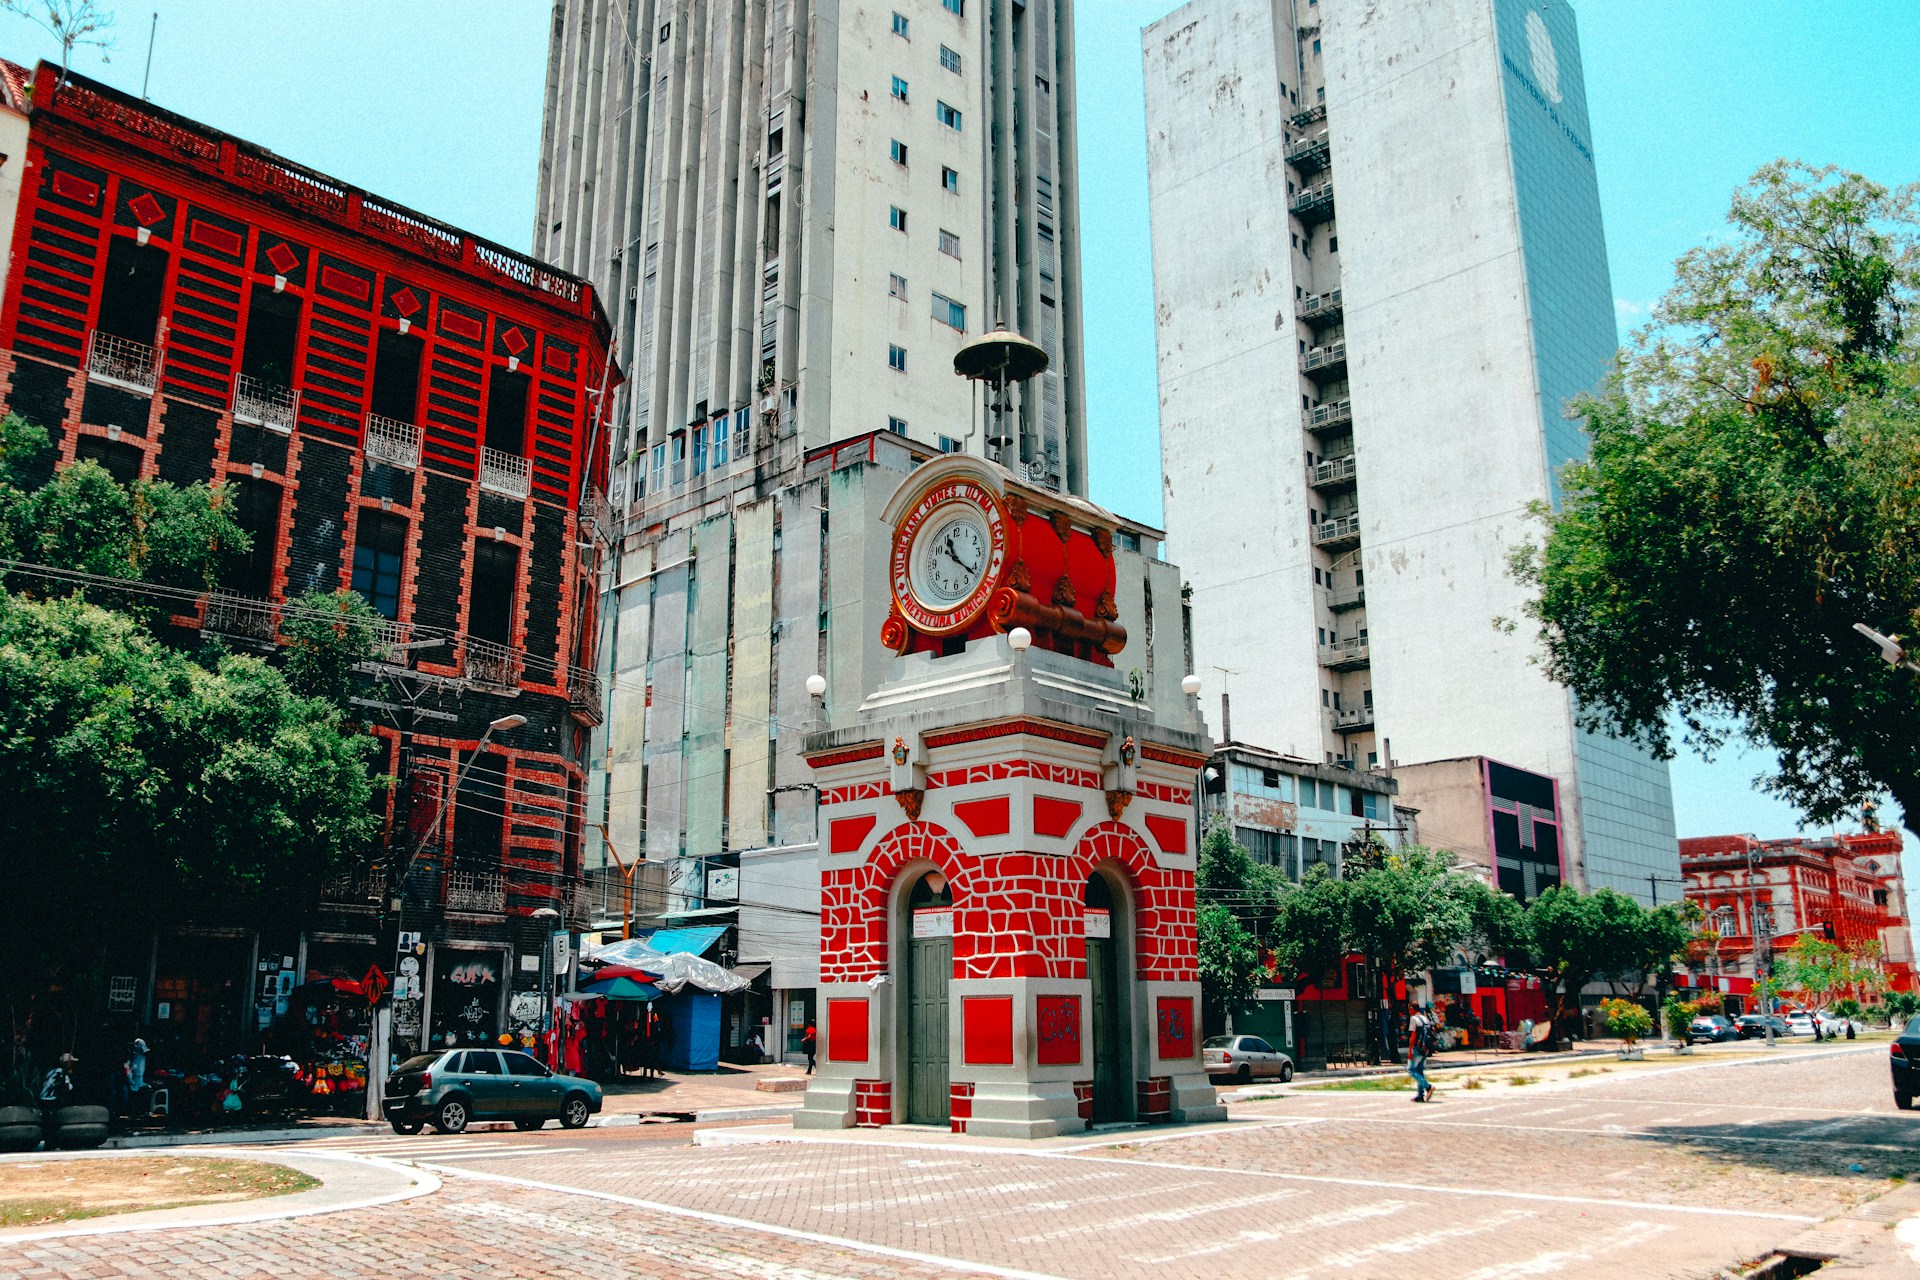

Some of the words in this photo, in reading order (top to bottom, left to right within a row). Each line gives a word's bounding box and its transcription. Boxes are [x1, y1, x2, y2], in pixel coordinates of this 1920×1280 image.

[1503, 53, 1547, 111] MINISTÉRIO
[1549, 107, 1560, 126] DA
[953, 527, 961, 538] 12
[972, 535, 978, 545] 2
[935, 545, 943, 556] 10
[975, 547, 981, 557] 3
[932, 559, 937, 570] 9
[972, 561, 978, 570] 4
[935, 571, 941, 581] 8
[963, 574, 969, 585] 5
[943, 579, 949, 590] 7
[953, 579, 959, 591] 6
[559, 940, 564, 952] E
